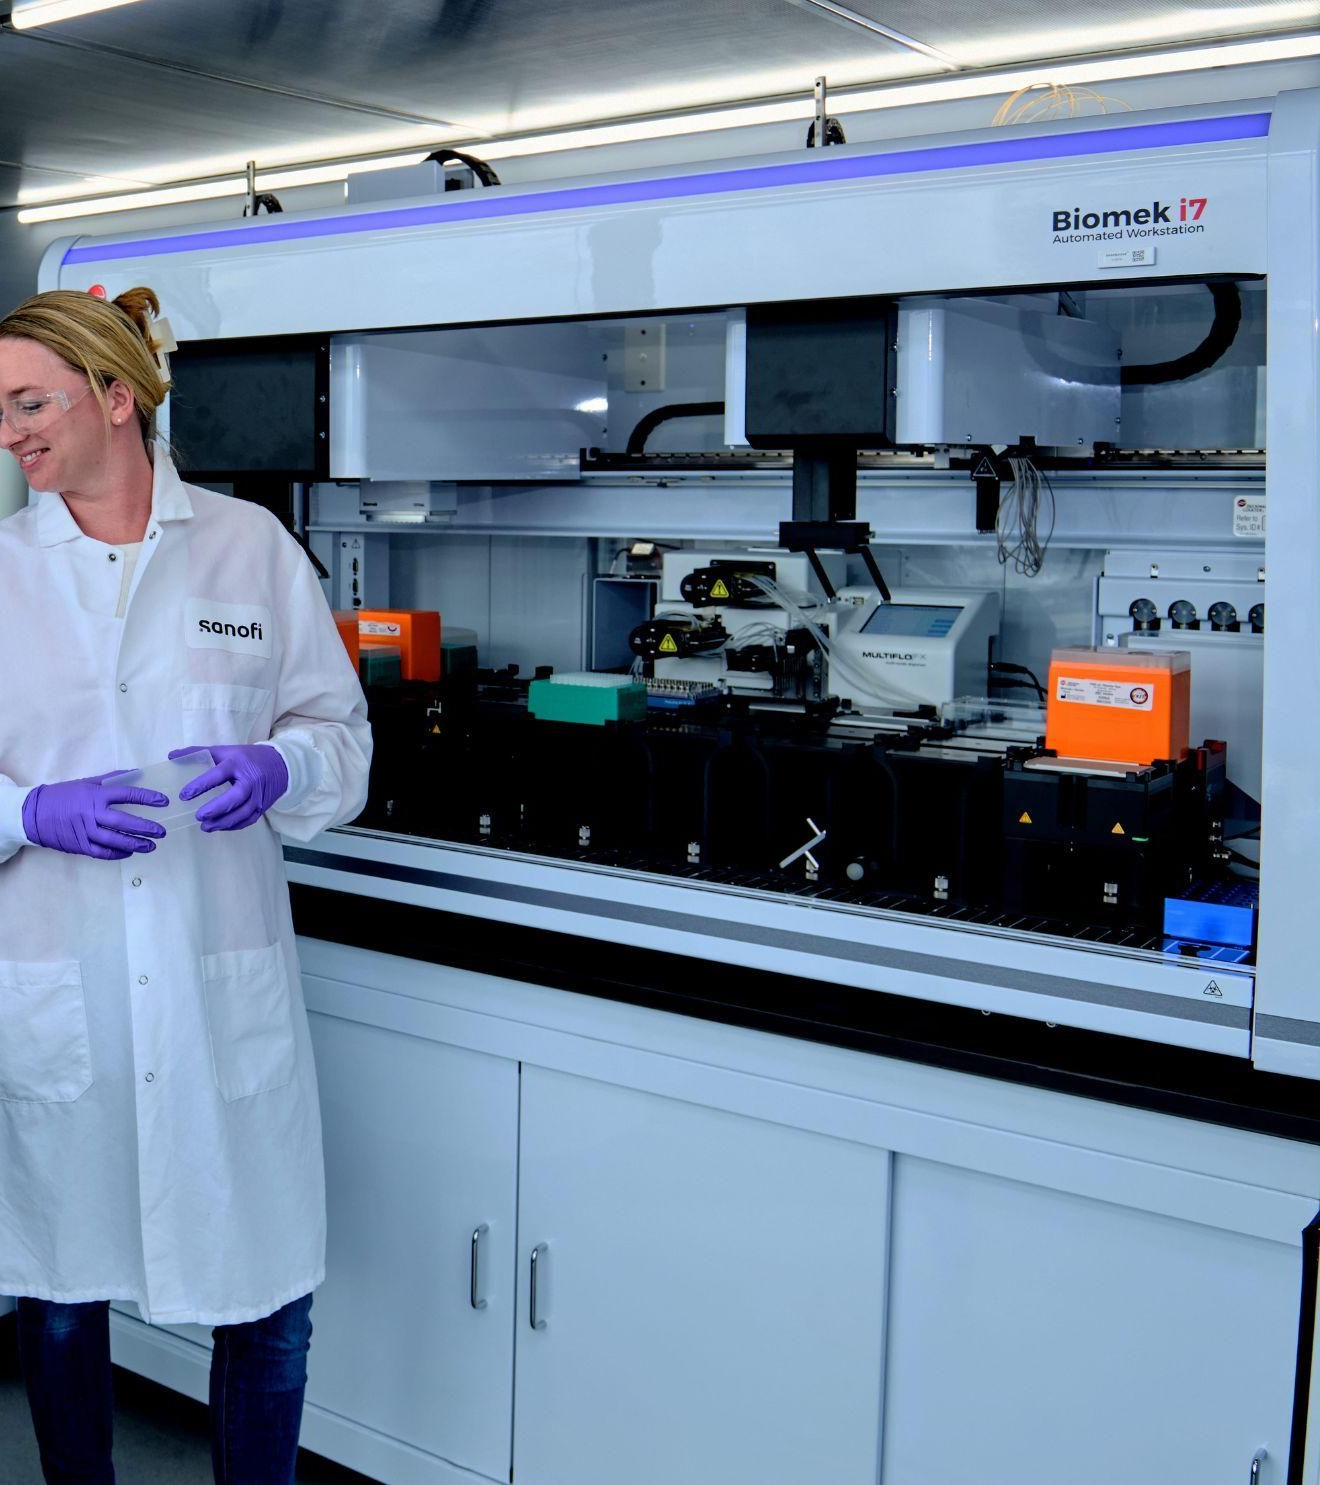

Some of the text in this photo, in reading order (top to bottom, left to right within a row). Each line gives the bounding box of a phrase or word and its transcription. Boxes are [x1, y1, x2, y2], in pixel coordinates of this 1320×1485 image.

[1052, 197, 1208, 232] Biomek i7
[1052, 224, 1205, 244] Automated Workstation
[198, 619, 263, 641] sanofi
